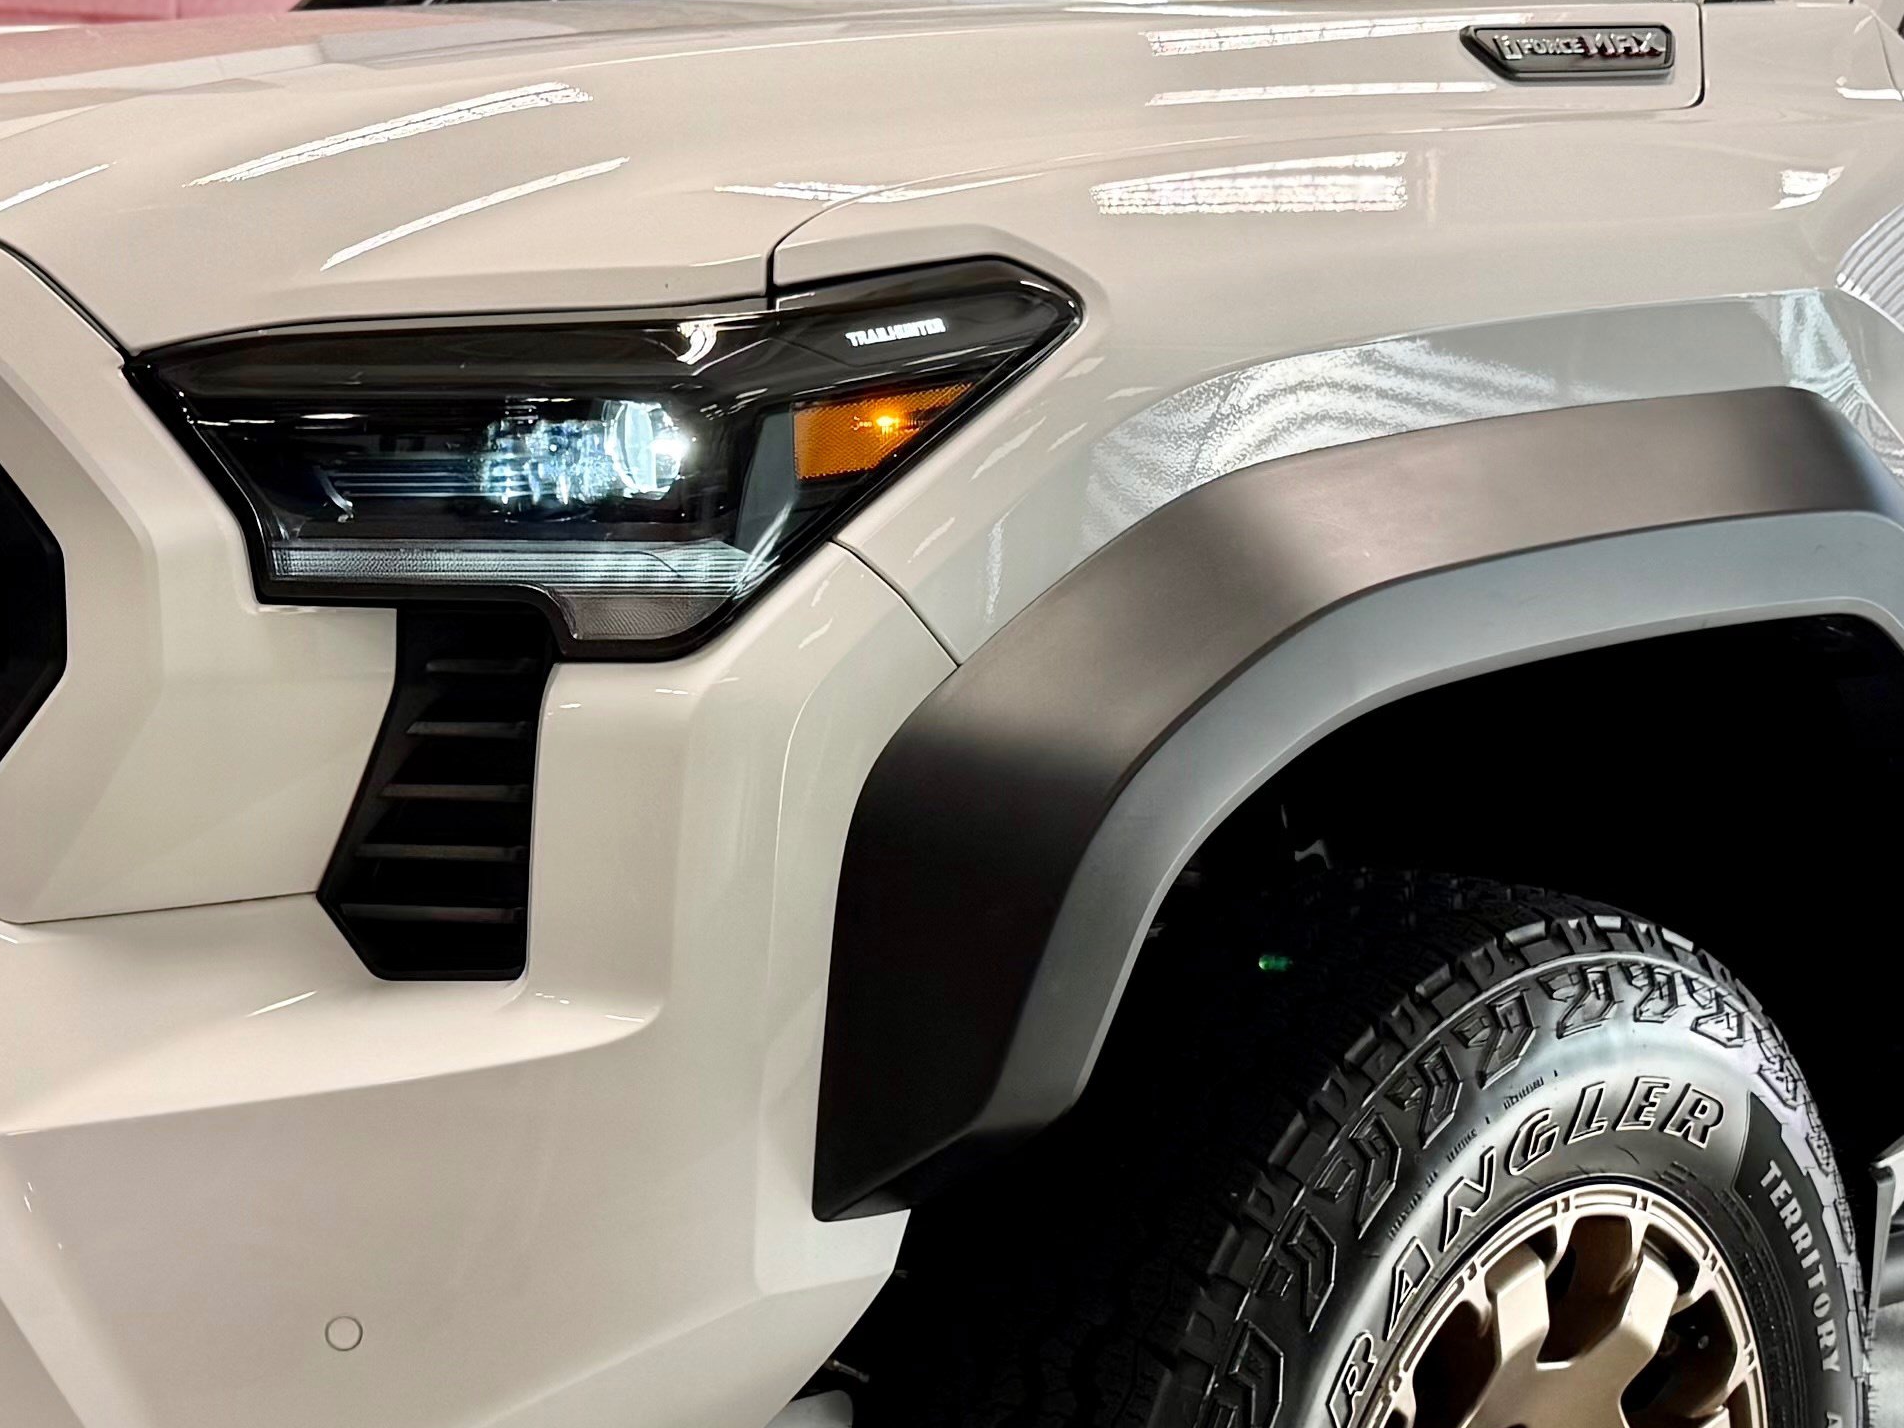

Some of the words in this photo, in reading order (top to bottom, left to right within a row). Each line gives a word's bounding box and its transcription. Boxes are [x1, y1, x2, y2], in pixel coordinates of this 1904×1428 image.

[1581, 33, 1665, 56] MAX
[846, 318, 946, 347] TRAILHUNTER
[1758, 1158, 1844, 1374] TERRITORY
